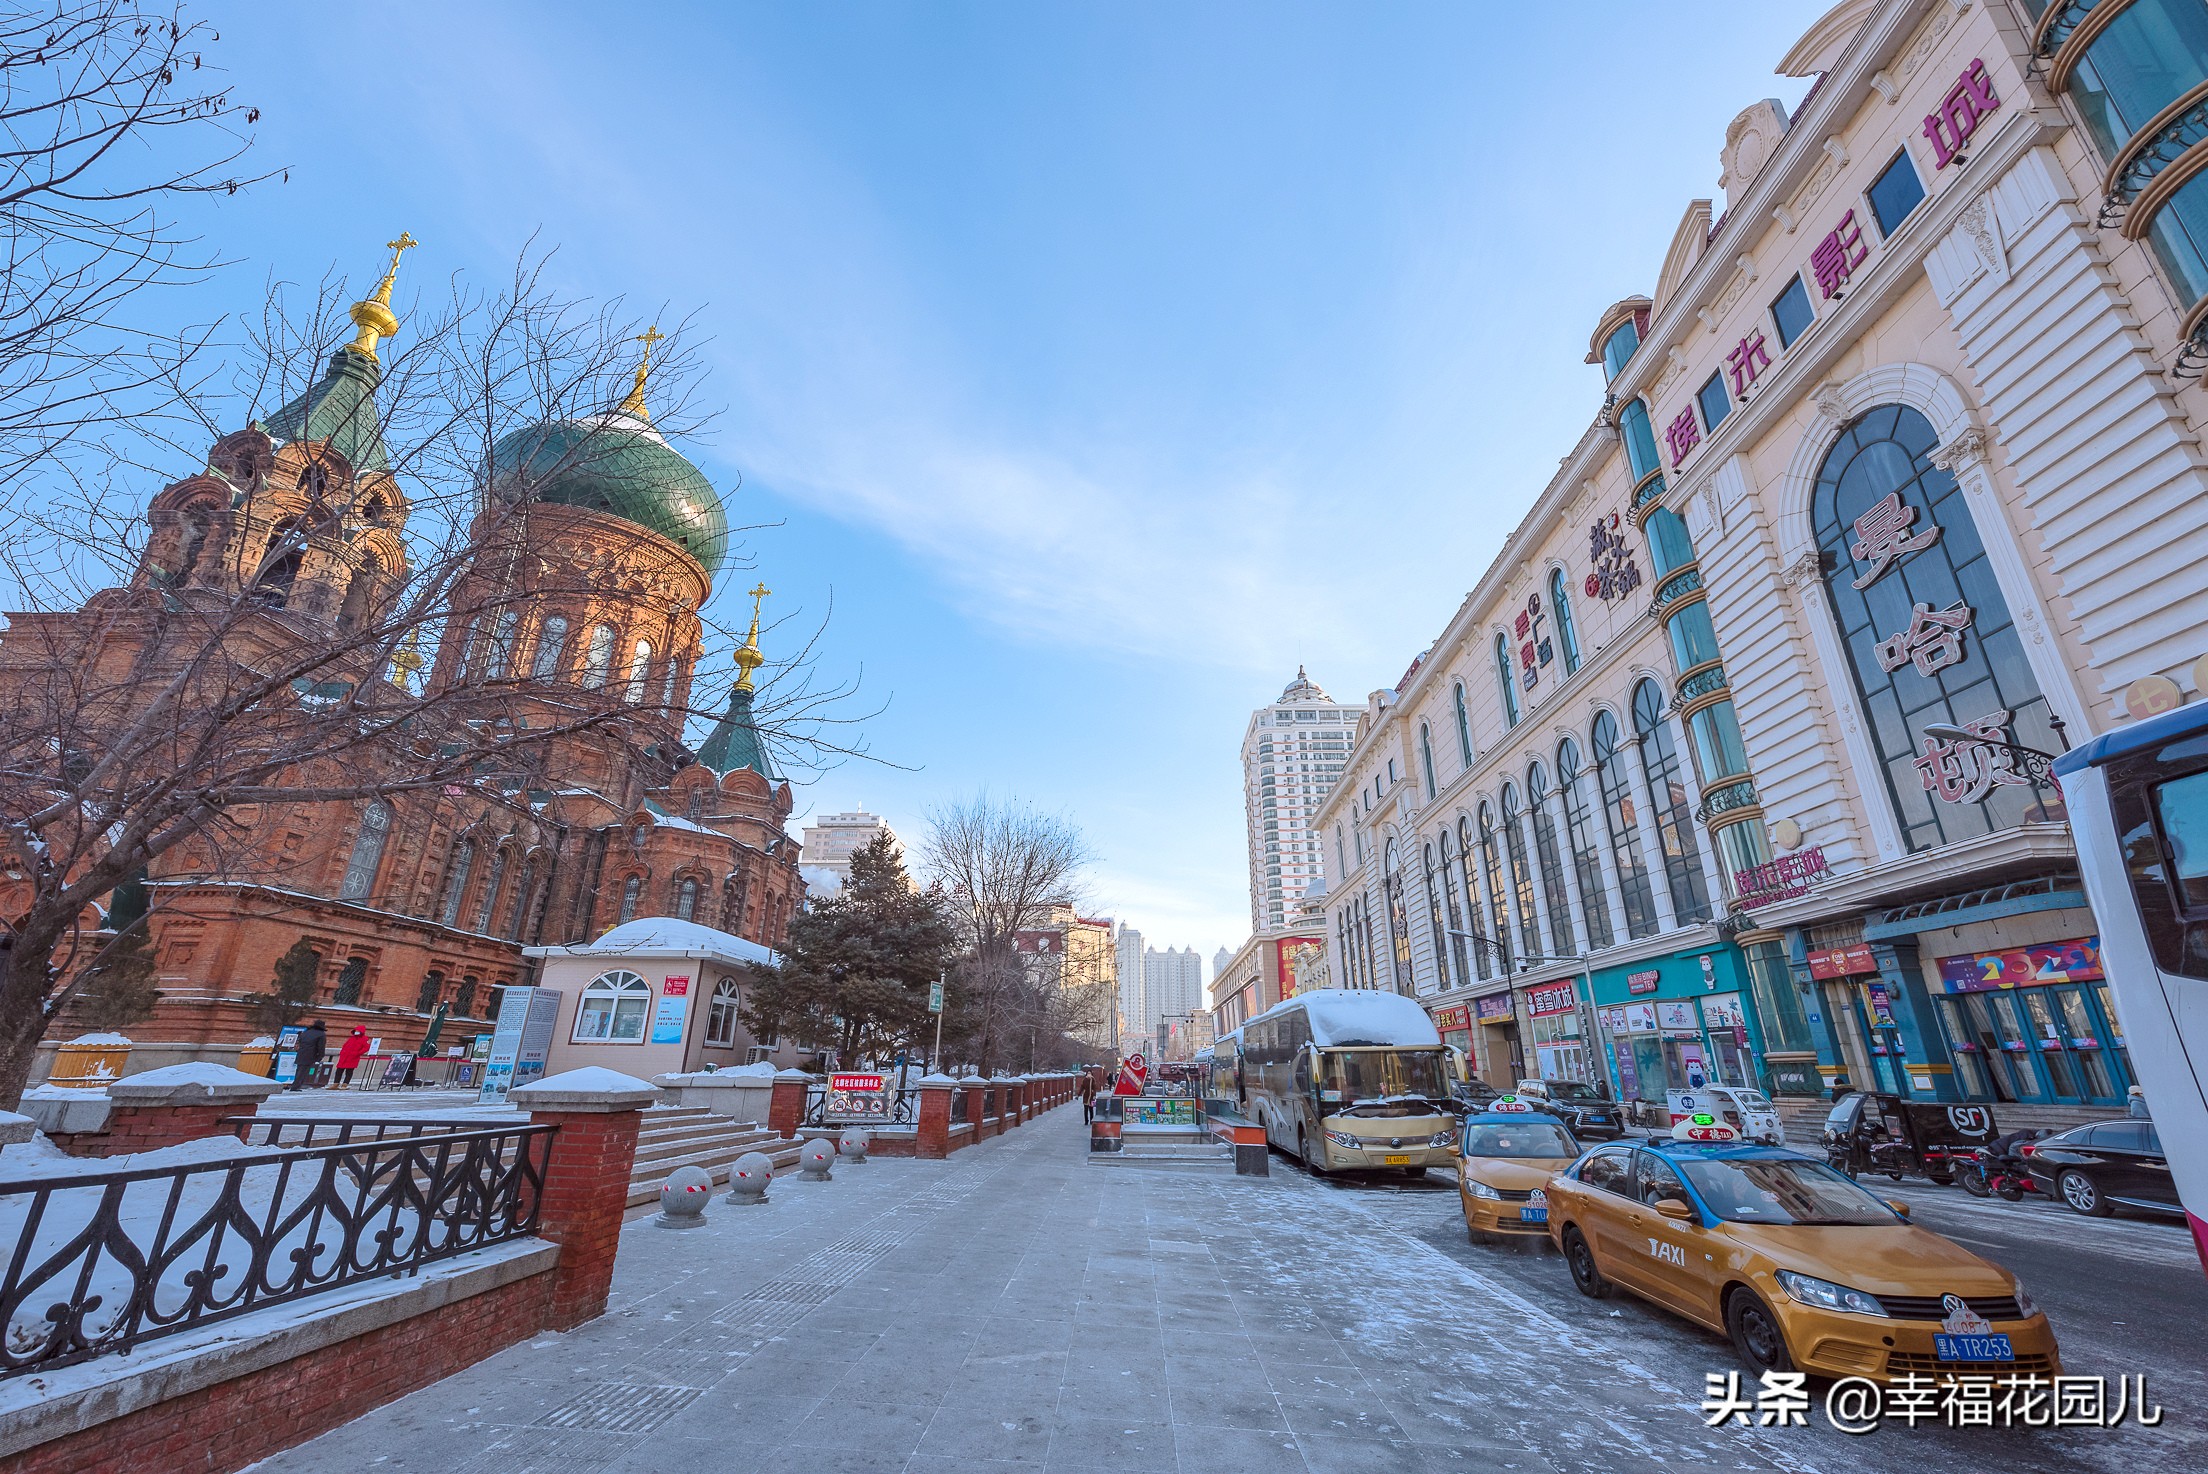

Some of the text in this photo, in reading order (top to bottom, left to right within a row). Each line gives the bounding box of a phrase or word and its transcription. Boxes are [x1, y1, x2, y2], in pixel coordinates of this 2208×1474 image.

[1852, 492, 2031, 804] 曼哈顿
[1535, 985, 1574, 1012] 蜜雪冰城
[1691, 1128, 1721, 1139] 中德
[1648, 1238, 1686, 1267] TAXI
[1946, 1321, 1990, 1334] 400871
